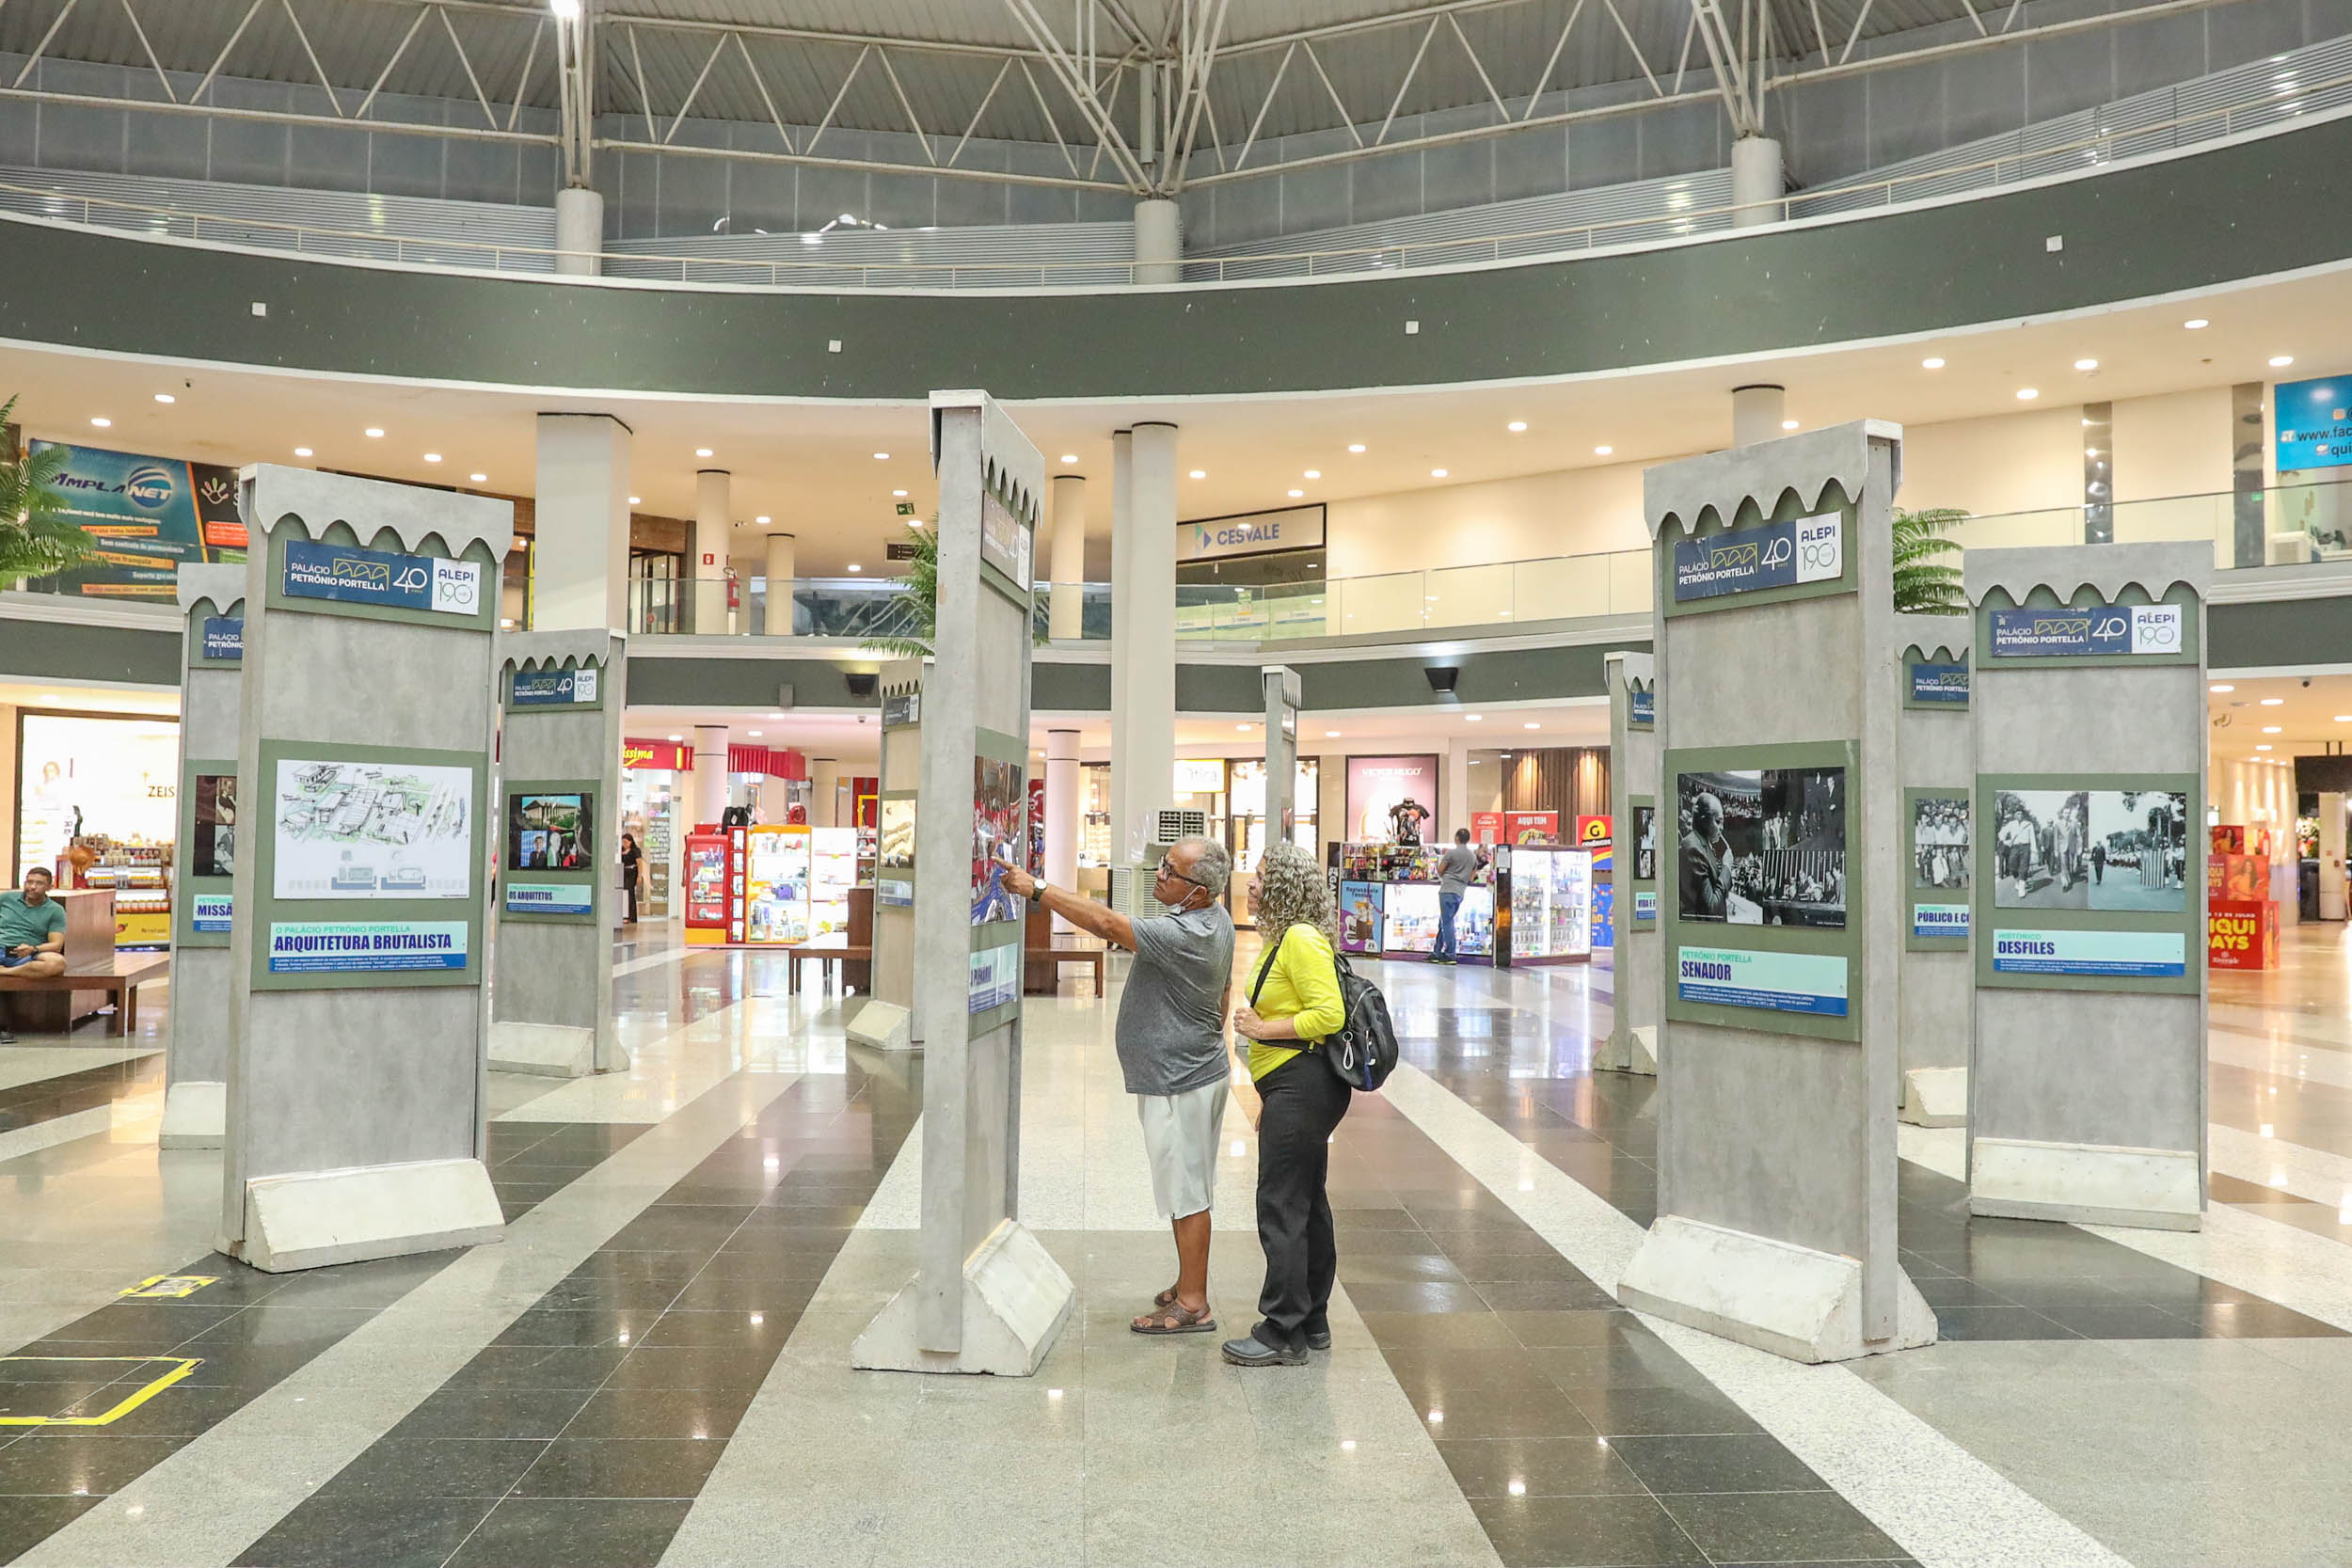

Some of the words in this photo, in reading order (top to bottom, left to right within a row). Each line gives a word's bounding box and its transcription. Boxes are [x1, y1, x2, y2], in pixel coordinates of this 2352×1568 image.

[128, 486, 173, 499] NET
[1217, 524, 1279, 546] CESVALE
[1801, 525, 1836, 542] ALEPI
[1761, 537, 1792, 571] 40
[1801, 542, 1836, 571] 190
[291, 562, 330, 575] PALÁCIO
[438, 568, 474, 582] ALEPI
[1678, 562, 1709, 575] PALÁCIO
[1678, 570, 1714, 585] PETRÔNIO
[1716, 566, 1755, 579] PORTELLA
[291, 573, 337, 586] PETRÔNIO
[339, 578, 385, 592] PORTELLA
[392, 566, 428, 594] 40
[438, 581, 473, 605] 190
[2137, 614, 2174, 624] ALEPI
[1996, 626, 2032, 635] PALÁCIO
[2092, 617, 2127, 642] 40
[2137, 626, 2174, 645] 190
[1996, 634, 2039, 644] PETRÔNIO
[2040, 635, 2085, 643] PORTELLA
[557, 677, 573, 694] 40
[1590, 825, 1600, 837] G
[1917, 911, 1952, 923] PÚBLICO
[1954, 912, 1959, 923] E
[275, 935, 370, 952] ARQUITETURA
[373, 934, 452, 950] BRUTALISTA
[1998, 941, 2055, 955] DESFILES
[1717, 952, 1753, 963] PORTELLA
[1681, 960, 1732, 981] SENADOR
